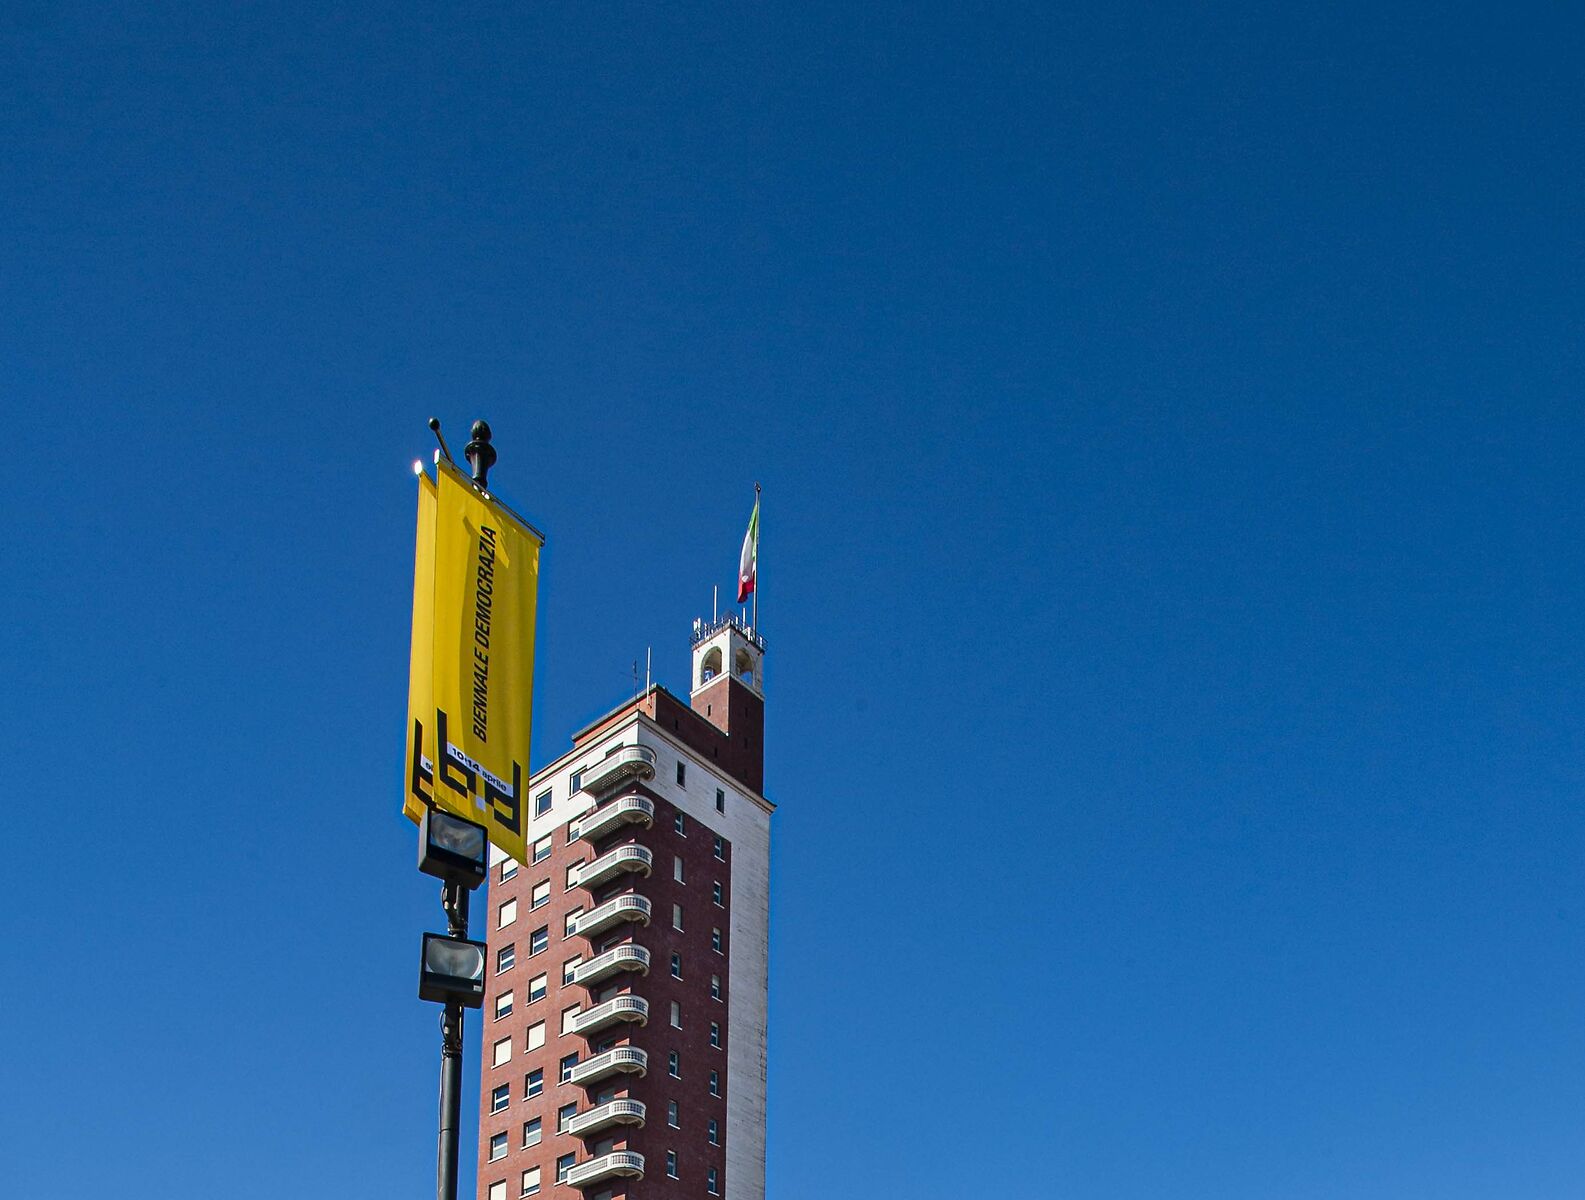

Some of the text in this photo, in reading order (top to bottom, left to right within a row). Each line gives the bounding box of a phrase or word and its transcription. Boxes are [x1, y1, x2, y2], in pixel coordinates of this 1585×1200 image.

[472, 525, 497, 744] BIENNALE DEMOCRAZIA
[481, 770, 507, 792] aprile
